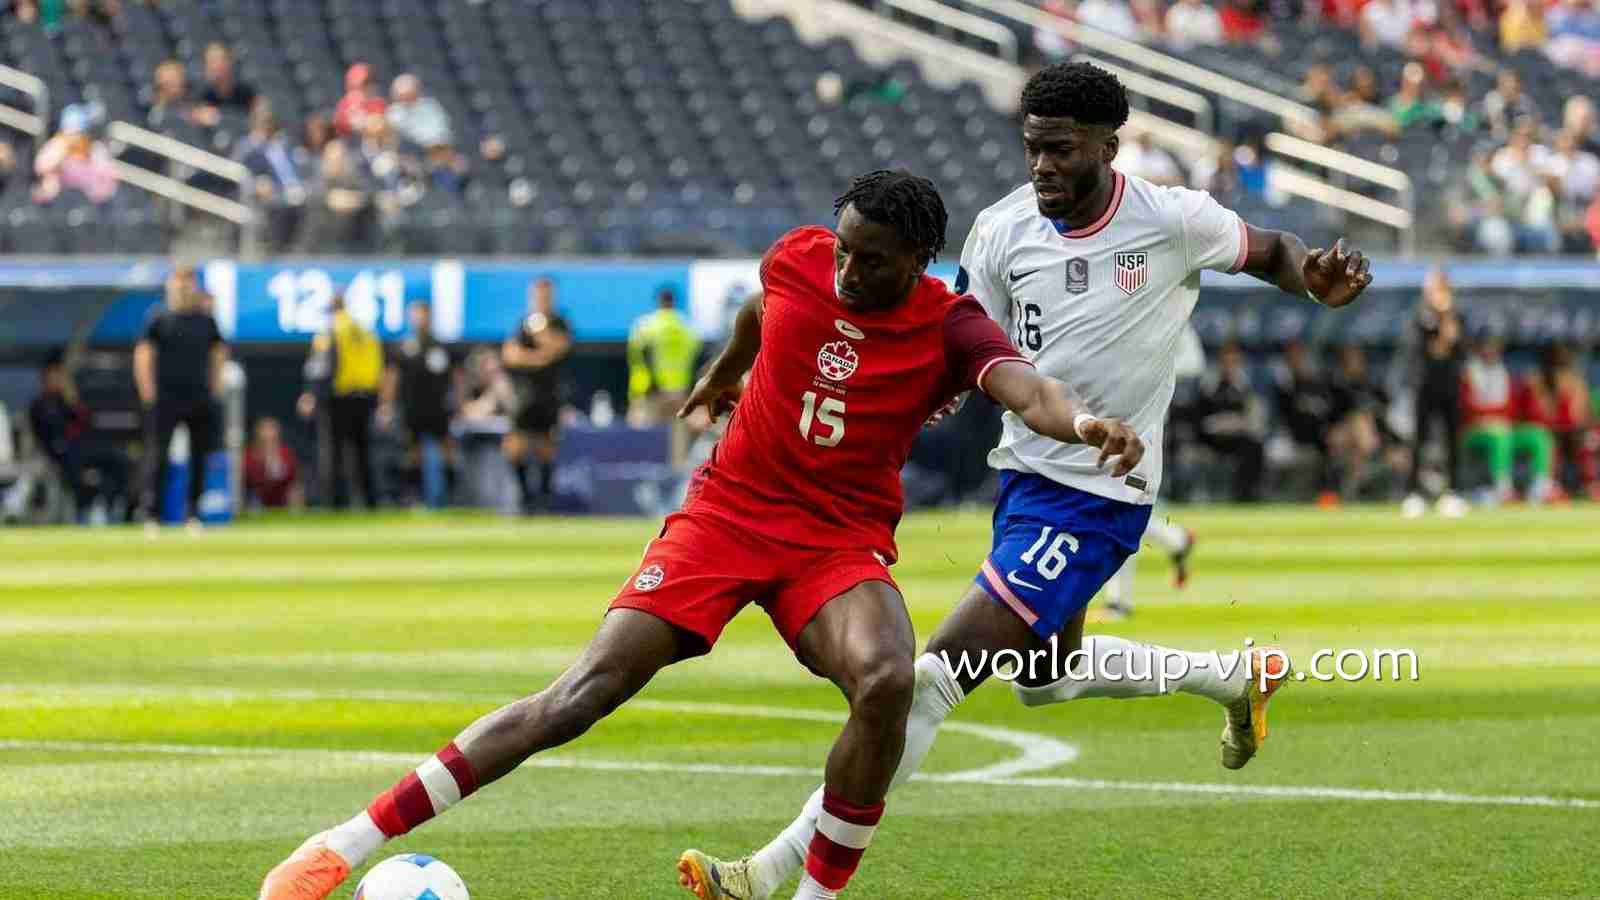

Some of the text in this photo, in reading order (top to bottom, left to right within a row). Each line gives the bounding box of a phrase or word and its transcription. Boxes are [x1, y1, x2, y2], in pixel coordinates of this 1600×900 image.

[1117, 254, 1145, 271] USA
[1016, 300, 1043, 352] 16
[820, 351, 855, 370] CANADA
[799, 391, 846, 447] 15
[1020, 526, 1079, 580] 16
